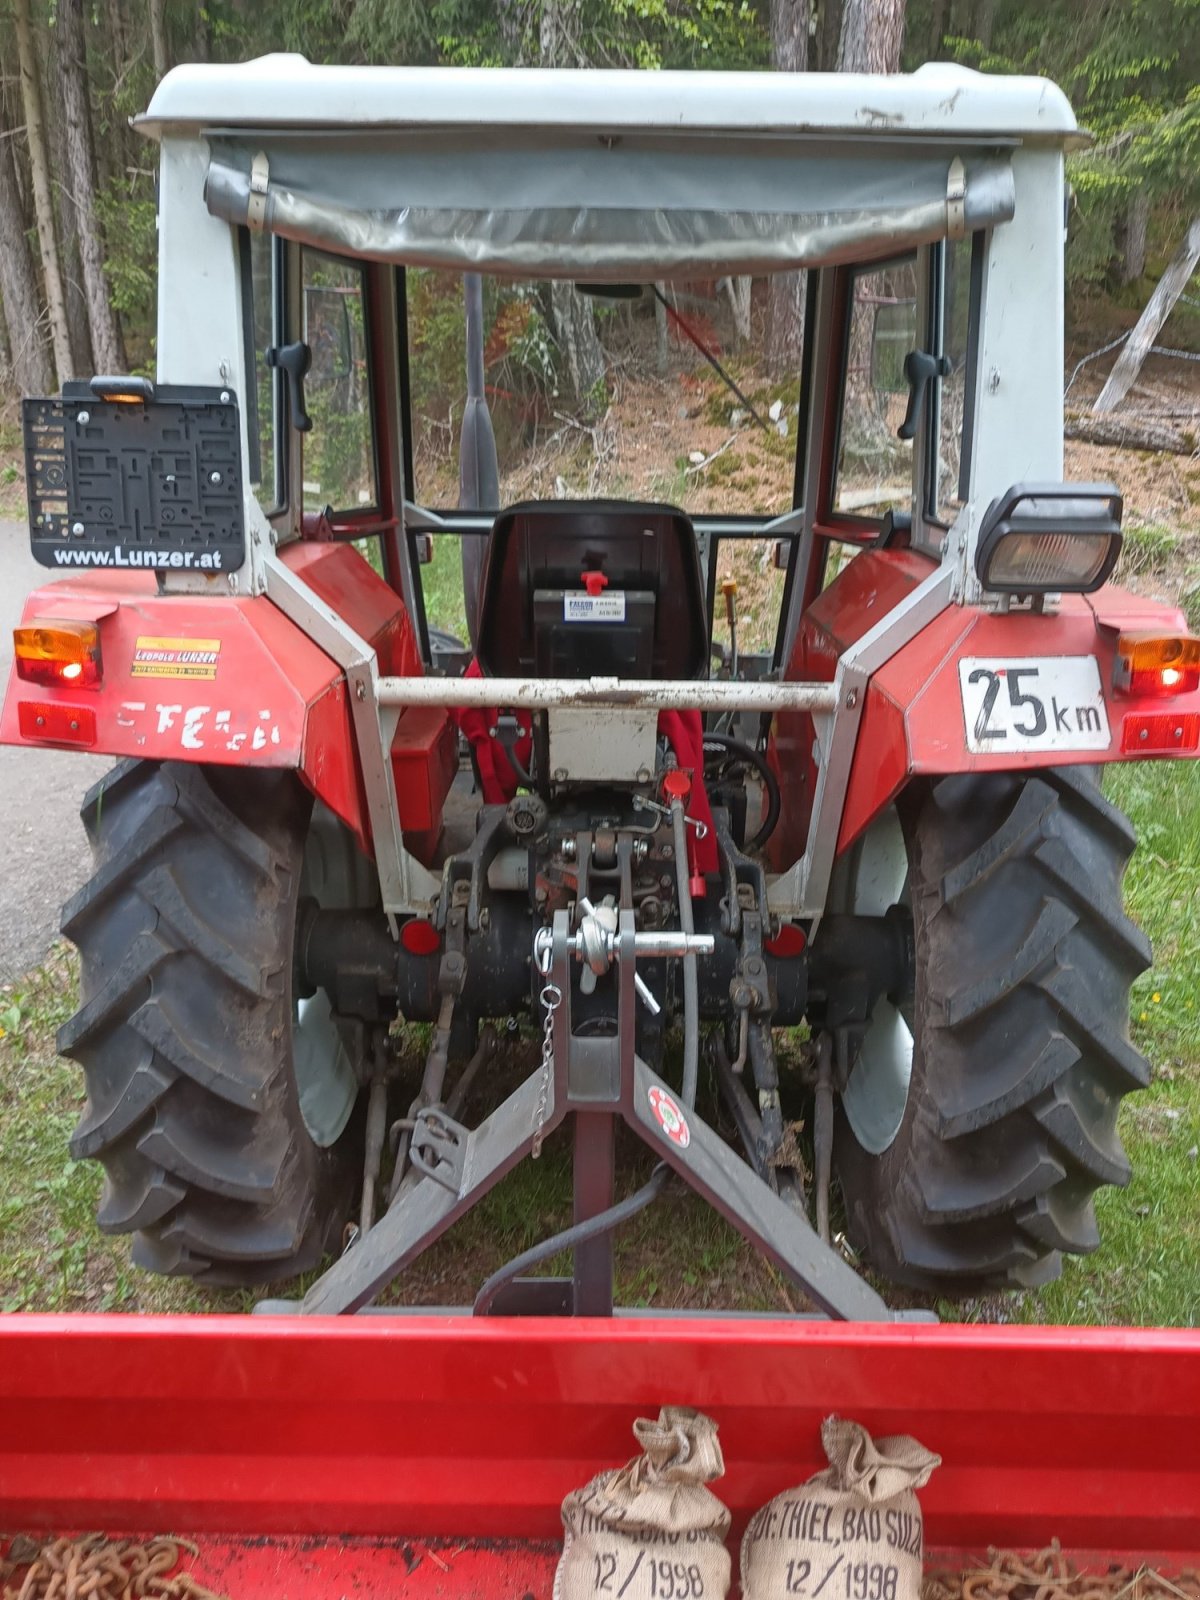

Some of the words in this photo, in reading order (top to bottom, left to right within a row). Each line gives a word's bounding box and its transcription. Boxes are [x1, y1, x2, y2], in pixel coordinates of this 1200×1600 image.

[54, 545, 222, 569] www.Lunzer.at
[176, 651, 217, 664] LUNZER
[968, 668, 1048, 742] 25
[1051, 696, 1102, 733] km
